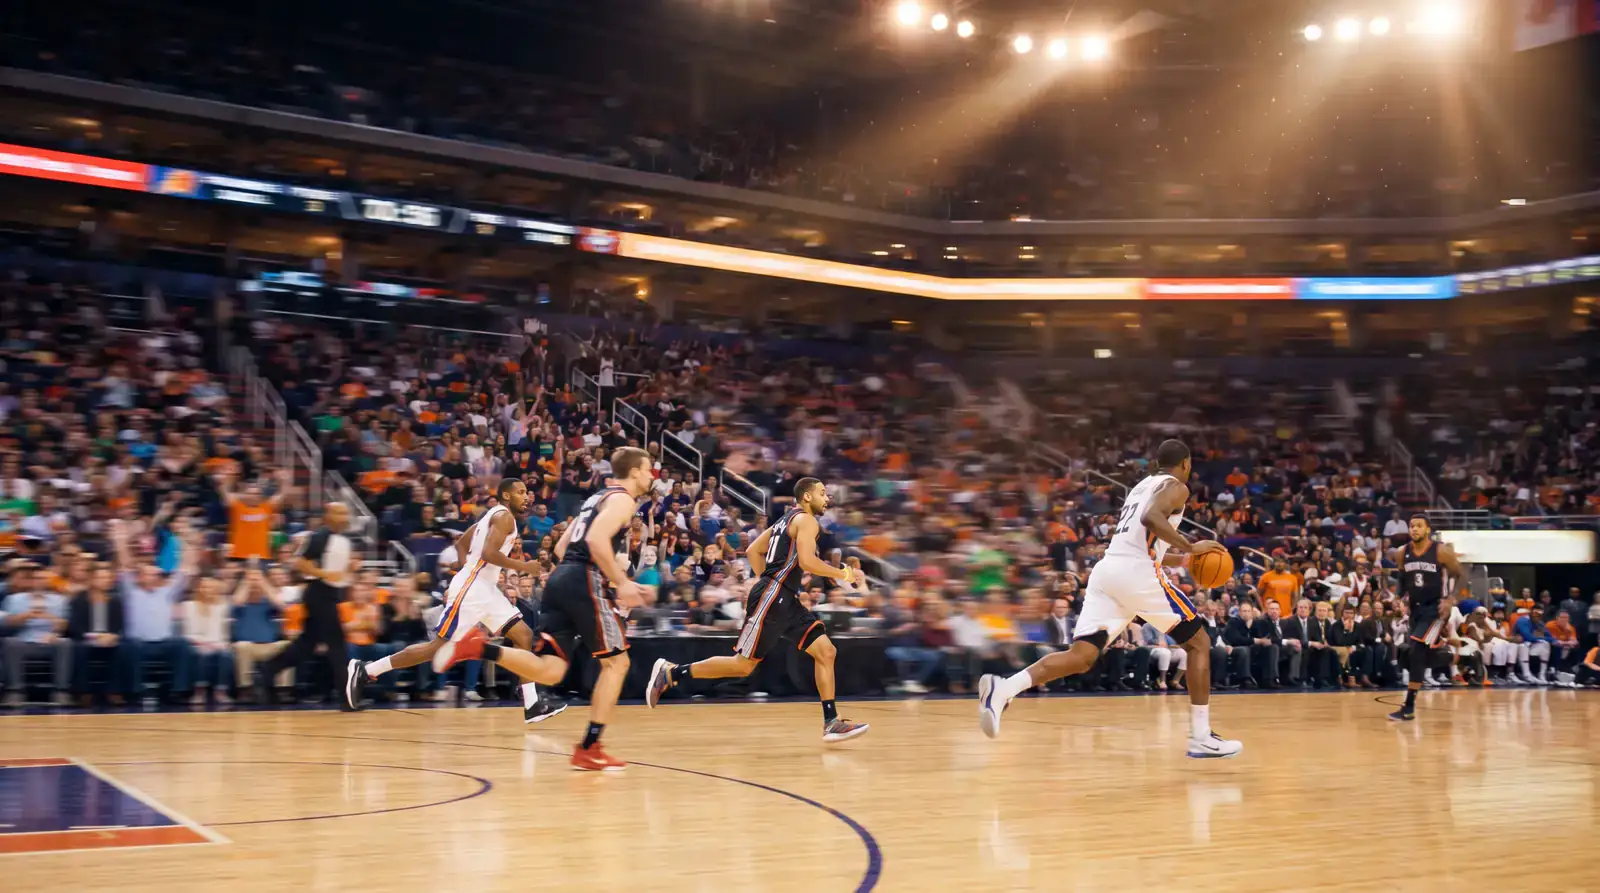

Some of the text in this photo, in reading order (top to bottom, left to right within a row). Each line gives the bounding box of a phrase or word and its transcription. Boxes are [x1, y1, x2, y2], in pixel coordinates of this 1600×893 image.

[1116, 502, 1139, 534] 22
[766, 535, 780, 563] 11
[1415, 573, 1424, 587] 3
